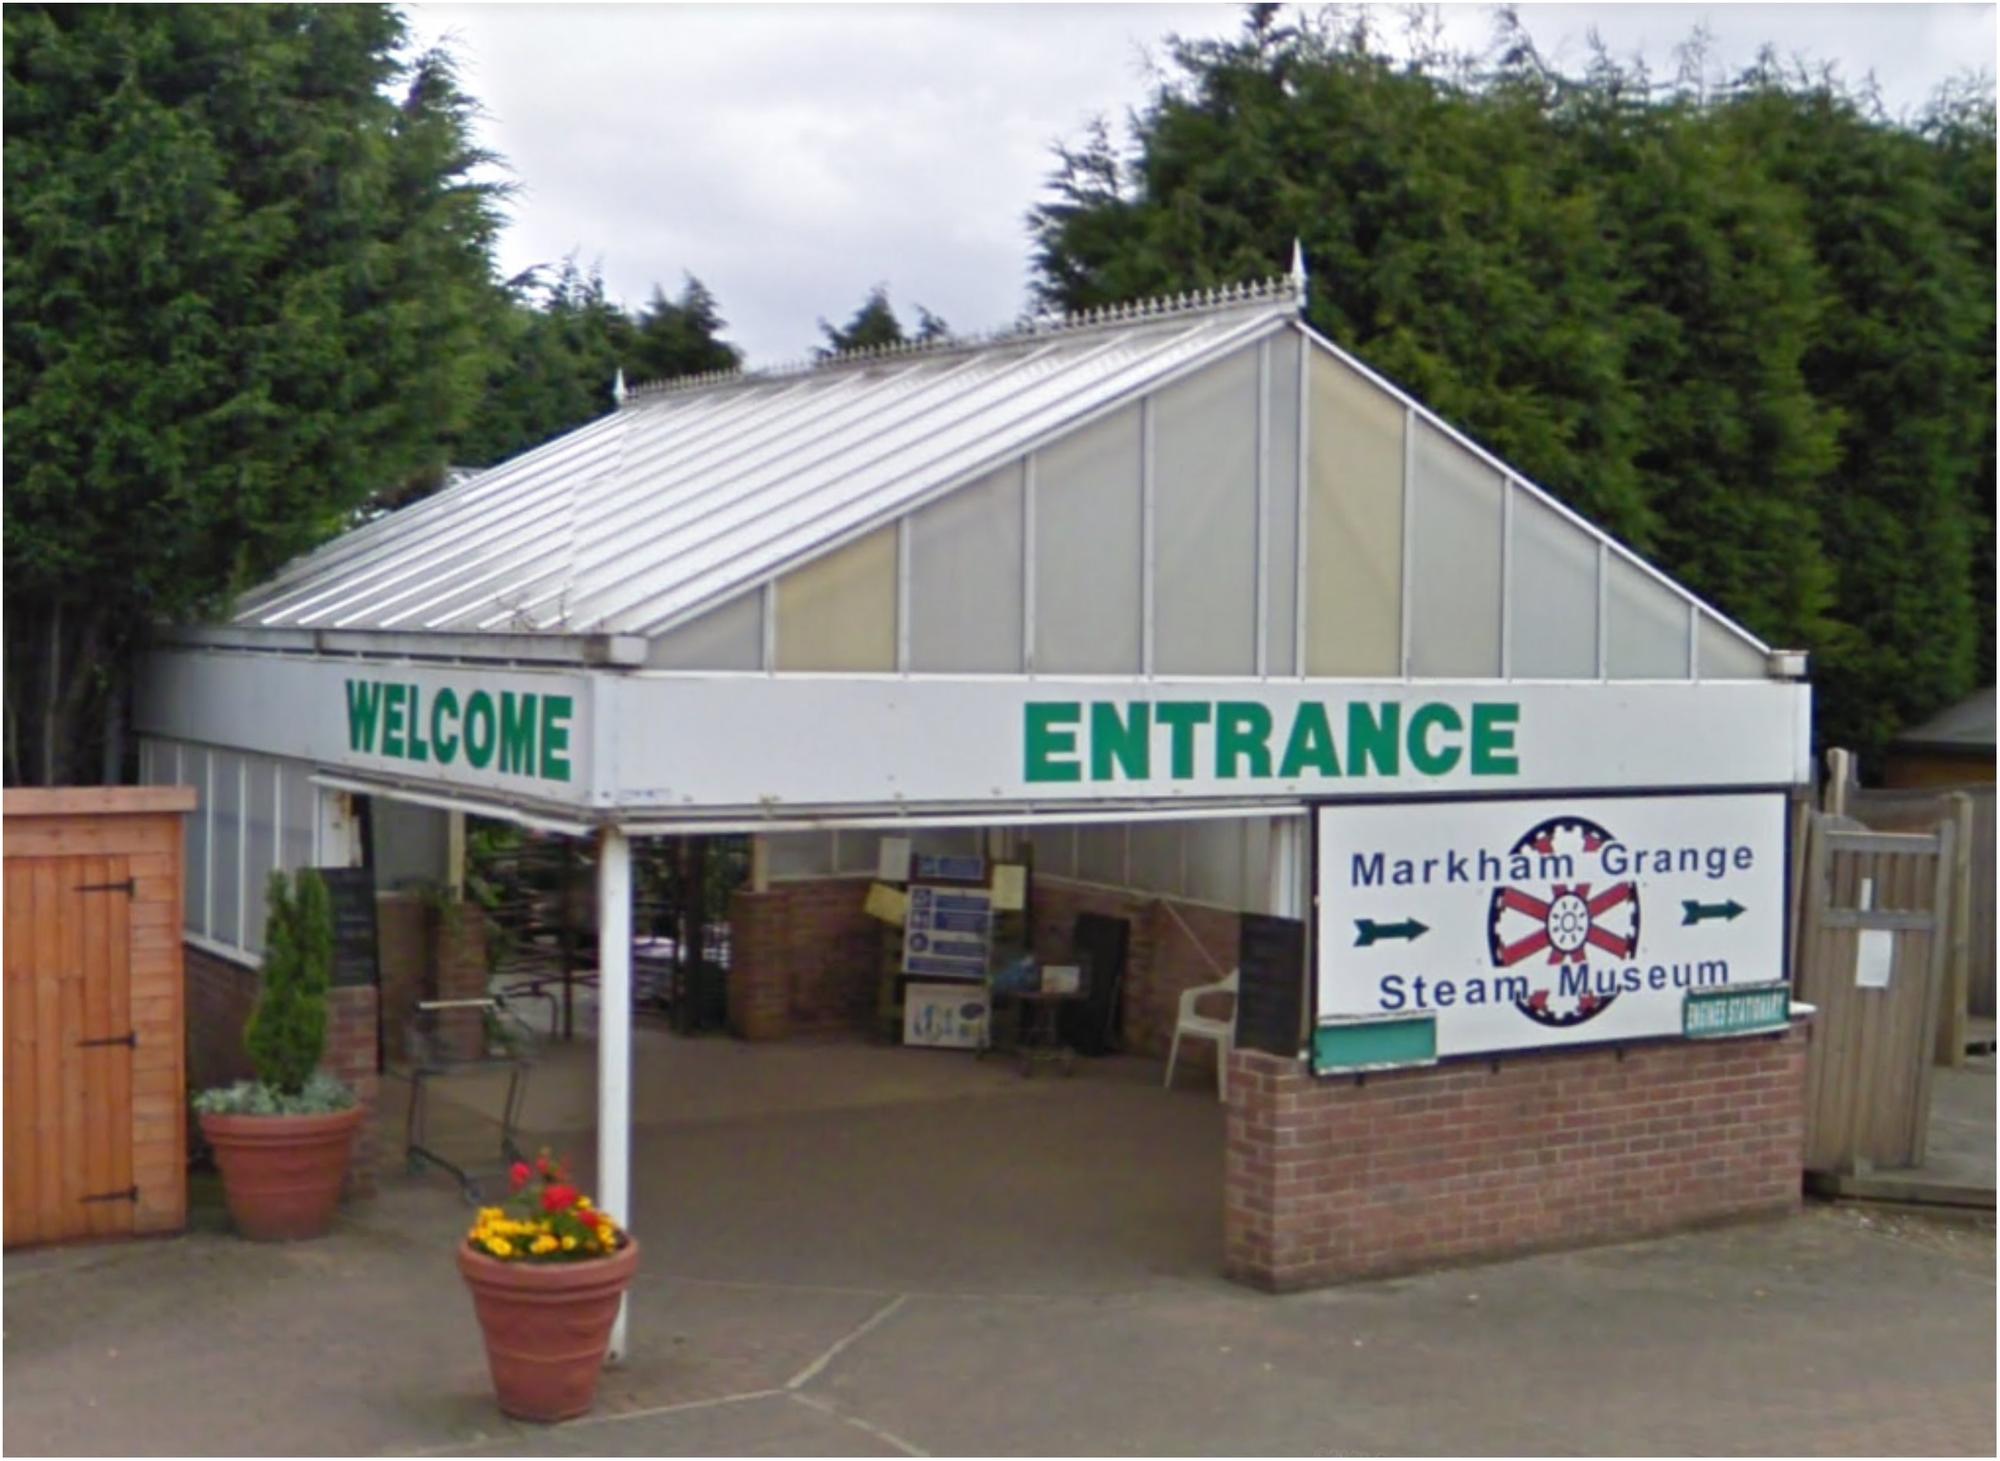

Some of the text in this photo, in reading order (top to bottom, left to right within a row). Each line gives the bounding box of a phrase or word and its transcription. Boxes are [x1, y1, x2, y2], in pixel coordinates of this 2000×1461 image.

[345, 679, 573, 782] WELCOME
[1023, 701, 1521, 783] ENTRANCE
[1351, 843, 1755, 886] Markham Grange
[1380, 960, 1729, 1011] Steam Museum
